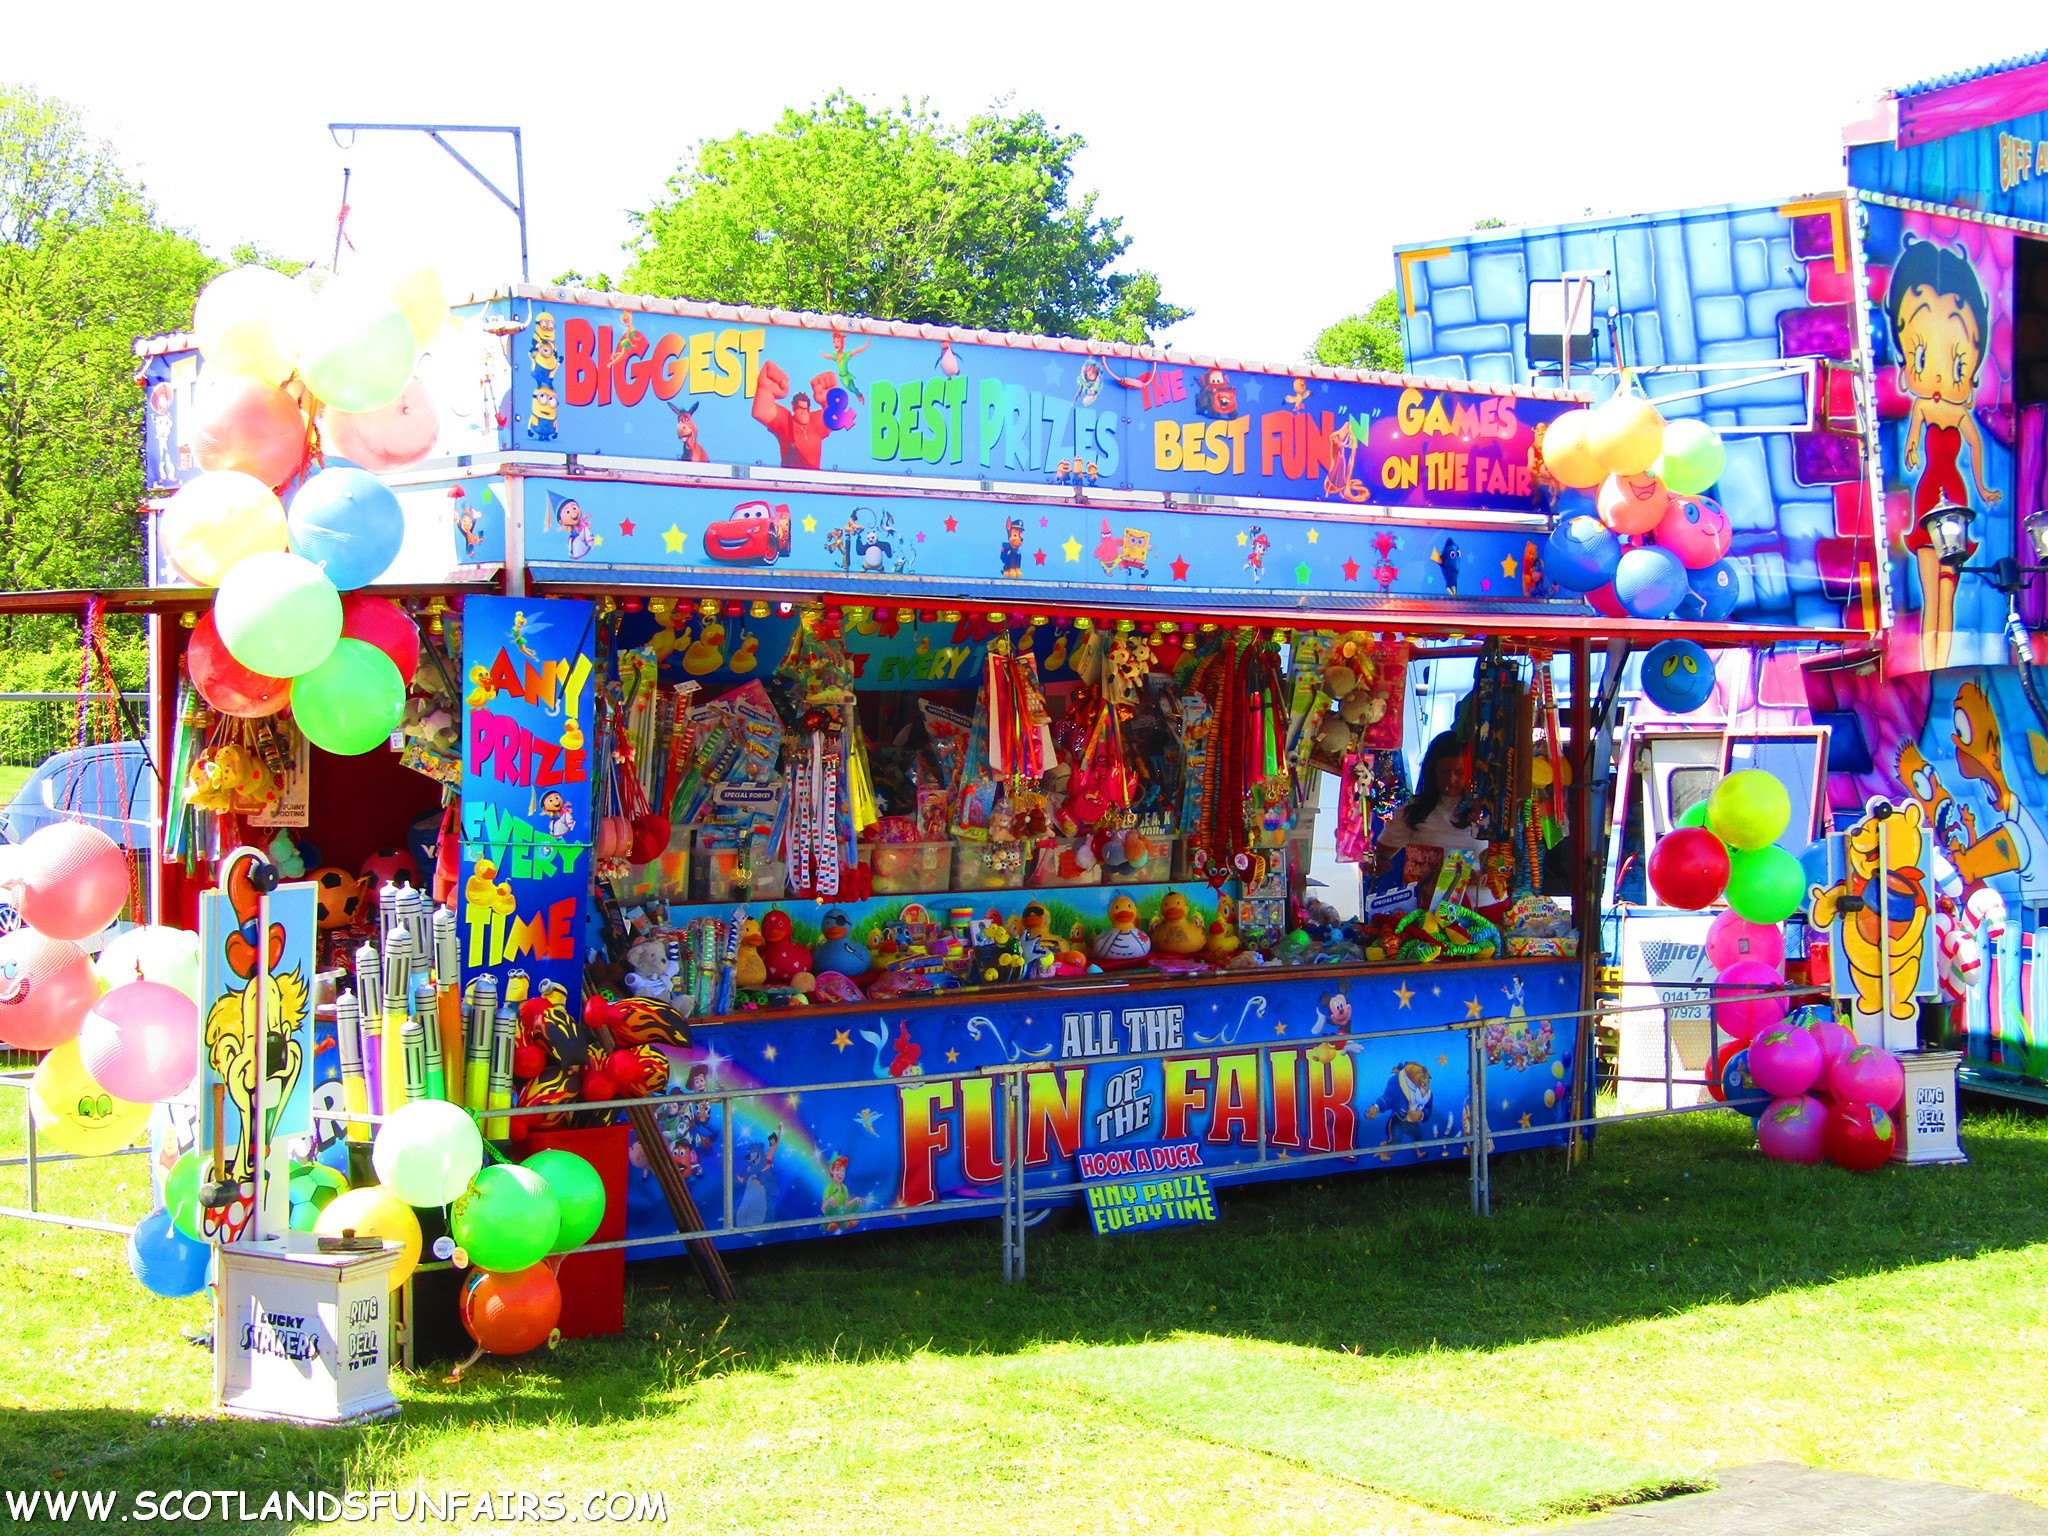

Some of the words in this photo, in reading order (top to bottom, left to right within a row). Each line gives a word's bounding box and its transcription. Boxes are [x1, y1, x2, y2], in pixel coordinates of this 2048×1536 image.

[1999, 131, 2032, 192] BIFF
[564, 318, 765, 408] BIGGEST
[870, 377, 969, 465] BEST
[980, 377, 1119, 477] PRIZES
[1138, 370, 1188, 413] THE
[1398, 388, 1518, 440] GAMES
[1154, 416, 1251, 476] BEST
[1261, 411, 1337, 480] FUN
[1381, 456, 1421, 491] ON
[1425, 451, 1469, 493] THE
[1475, 457, 1532, 498] FAIR
[488, 646, 593, 719] ANY
[877, 646, 971, 682] EVERY
[469, 709, 586, 788] PRIZE
[271, 810, 305, 818] SOOTING
[463, 800, 585, 881] EVERY
[465, 896, 577, 968] TIME
[1662, 991, 1690, 1003] 0141
[1061, 1012, 1121, 1059] ALL
[1124, 1005, 1185, 1053] THE
[1106, 1066, 1146, 1108] OF
[1162, 1047, 1358, 1155] FAIR
[1917, 1086, 1944, 1104] RING
[900, 1066, 1087, 1207] FUN
[1096, 1095, 1154, 1144] THE
[1916, 1109, 1945, 1126] BELL
[1079, 1149, 1136, 1178] HOOK
[1137, 1149, 1152, 1172] A
[1151, 1142, 1203, 1171] DUCK
[1142, 1175, 1210, 1202] PRIZE
[1094, 1197, 1216, 1235] EVERYTIME
[261, 1313, 305, 1329] LUCKY
[350, 1296, 378, 1325] RING
[241, 1322, 321, 1361] STRIKERS
[349, 1331, 378, 1359] BELL
[348, 1361, 359, 1371] TO
[362, 1356, 377, 1370] WIN
